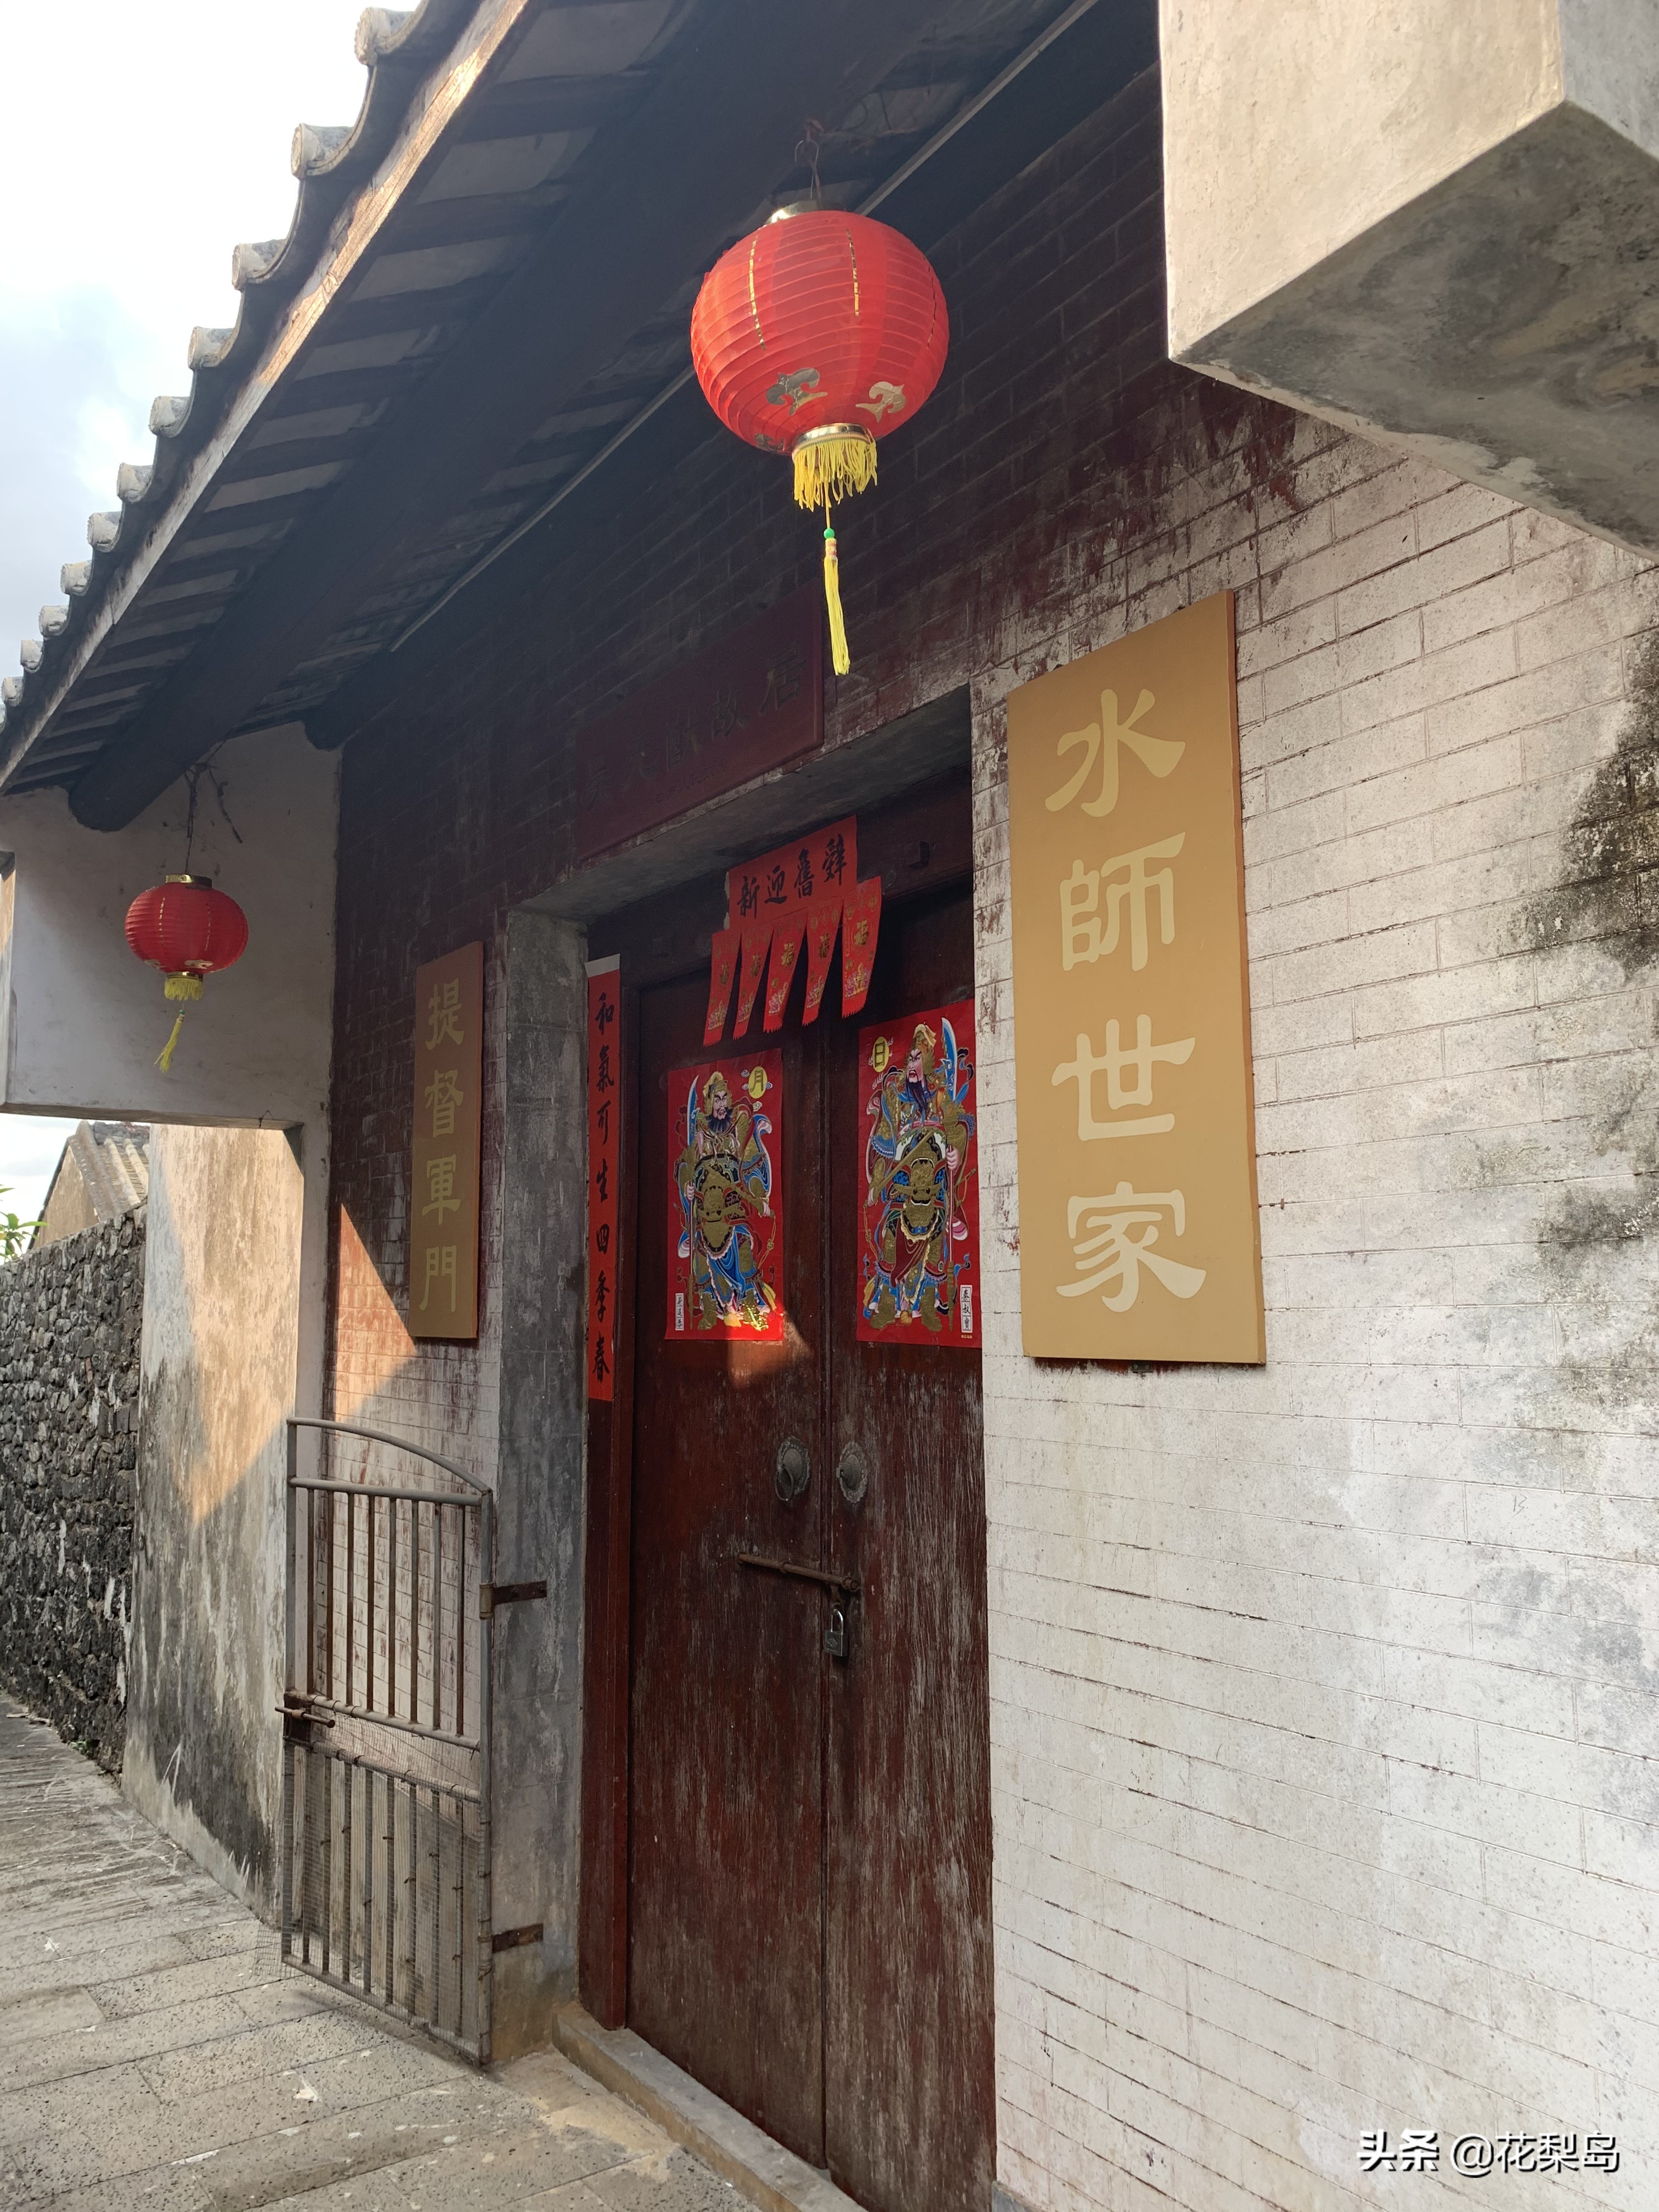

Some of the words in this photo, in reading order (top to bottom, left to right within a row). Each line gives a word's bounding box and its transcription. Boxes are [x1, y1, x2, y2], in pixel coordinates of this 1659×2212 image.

[749, 1070, 764, 1093] 月
[874, 1041, 885, 1068] 日
[1044, 688, 1206, 1313] 水師世家
[419, 978, 464, 1313] 提督軍門
